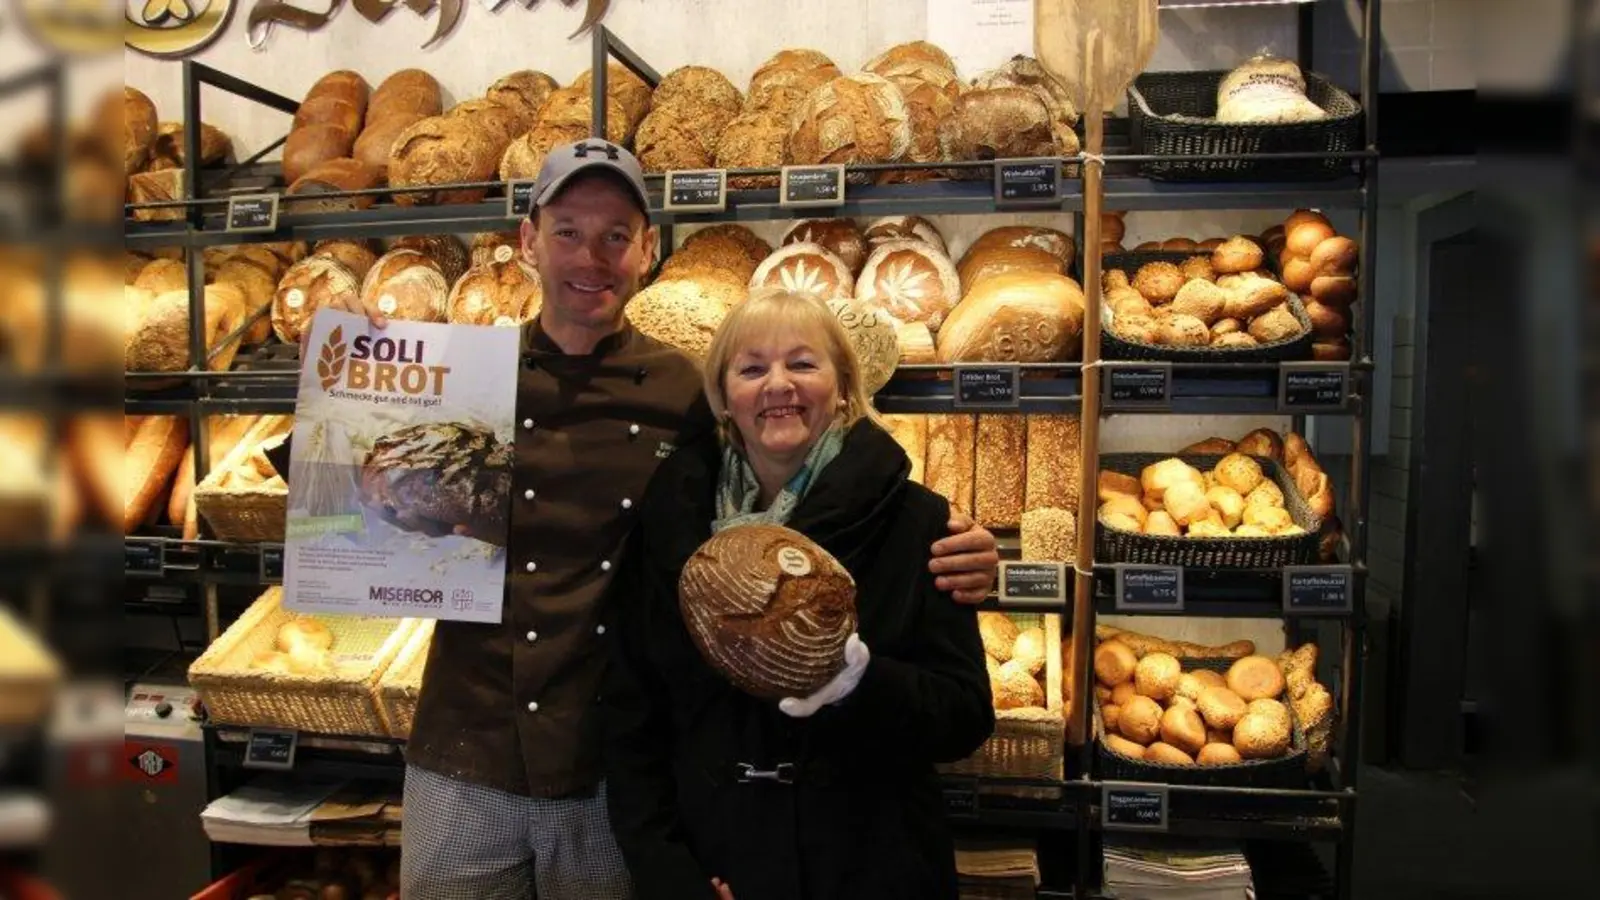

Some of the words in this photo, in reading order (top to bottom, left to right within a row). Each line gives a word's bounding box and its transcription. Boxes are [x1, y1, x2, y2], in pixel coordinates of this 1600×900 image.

[350, 334, 425, 363] SOLI
[346, 359, 452, 396] BROT
[329, 390, 372, 402] Schmeckt
[374, 394, 389, 405] gut
[391, 396, 407, 405] und
[409, 397, 421, 406] tut
[424, 397, 443, 408] gut!
[369, 586, 444, 604] MISEREOR
